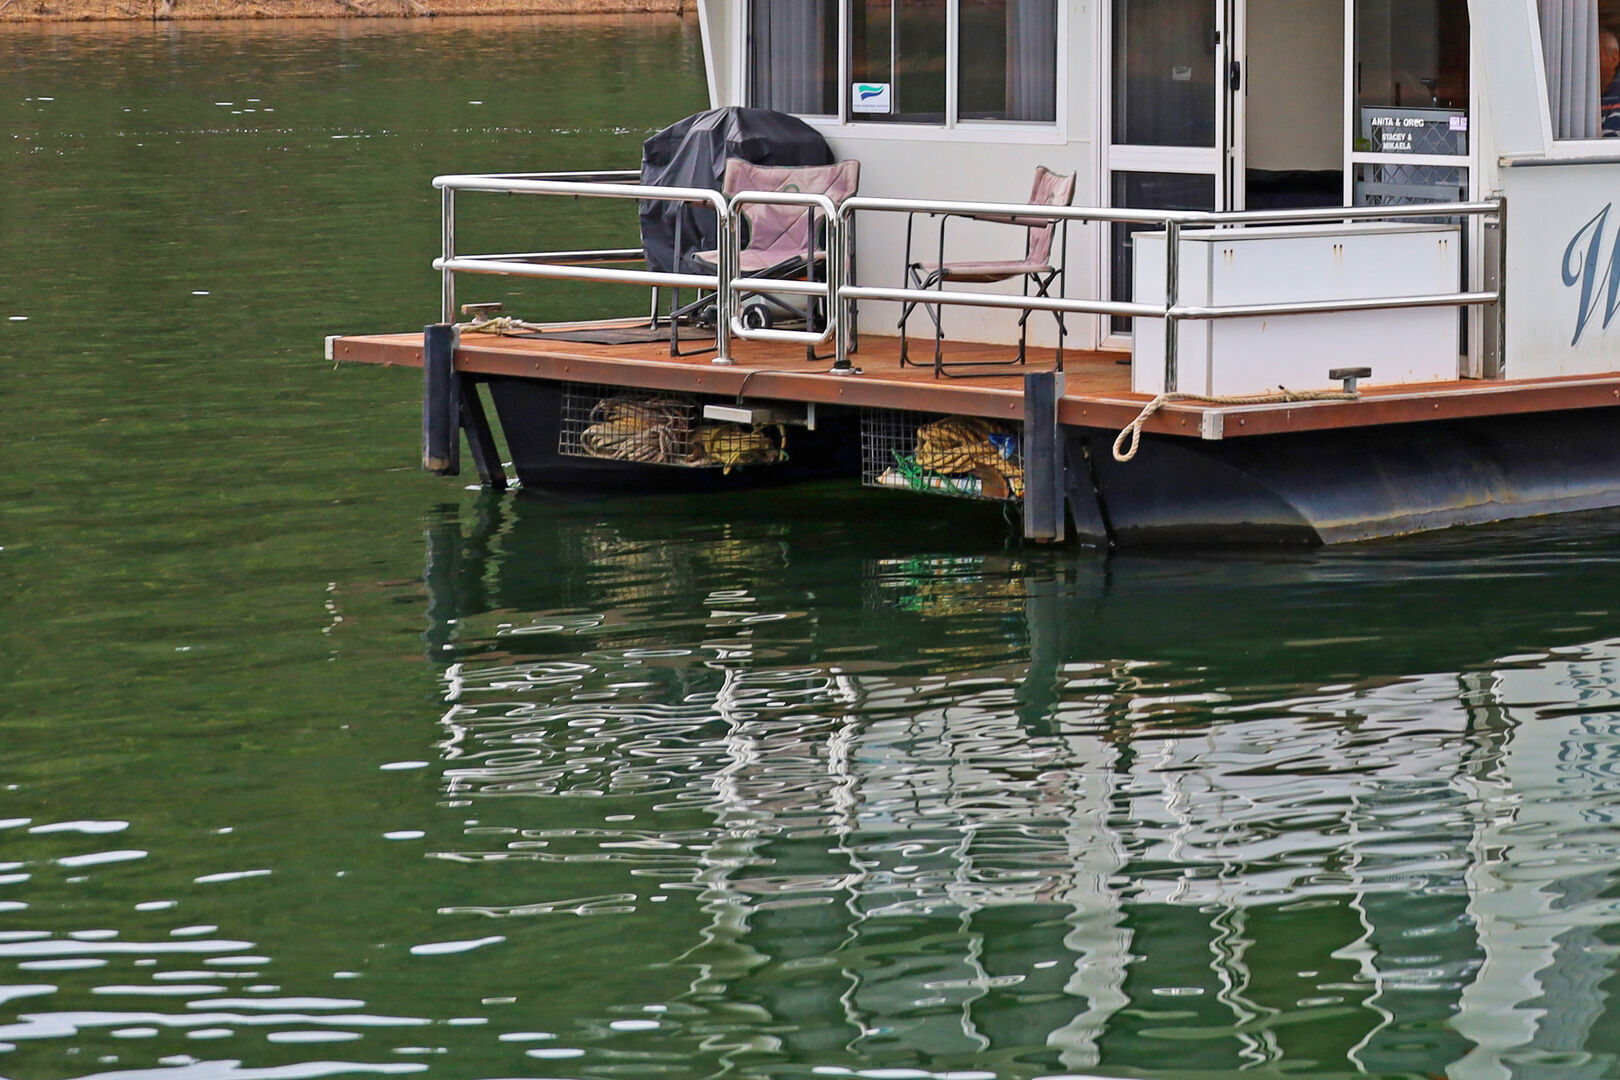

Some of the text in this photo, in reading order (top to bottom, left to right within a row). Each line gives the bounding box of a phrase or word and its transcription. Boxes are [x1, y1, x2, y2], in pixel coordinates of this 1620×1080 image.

[1371, 117, 1425, 127] ANITA & GREG
[1382, 133, 1406, 141] STACEY
[1382, 142, 1412, 150] MIKAELA
